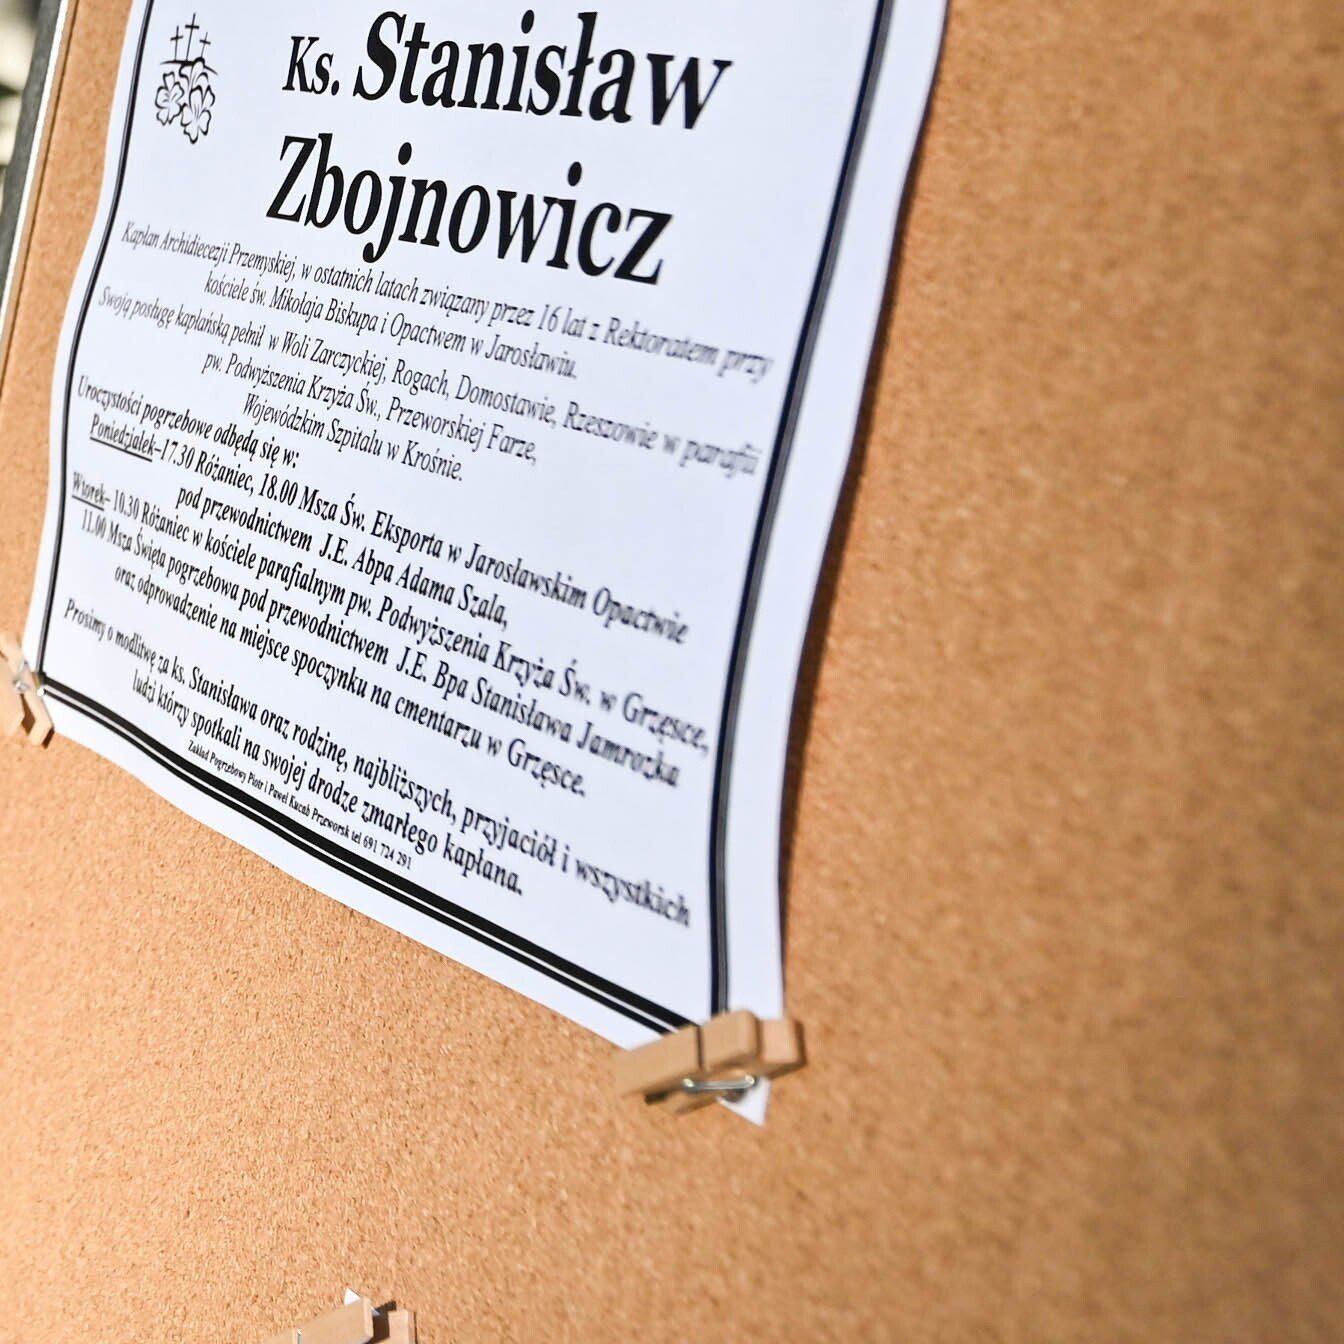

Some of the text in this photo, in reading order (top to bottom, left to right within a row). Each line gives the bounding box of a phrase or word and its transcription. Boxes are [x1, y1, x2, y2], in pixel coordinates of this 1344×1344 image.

[282, 9, 732, 130] Ks. Stanisław
[265, 132, 674, 286] Zbojnowicz
[159, 230, 231, 268] Archidiecezji
[228, 242, 298, 284] Przemyskiej,
[301, 263, 313, 281] w
[313, 265, 374, 294] ostatnich
[374, 270, 420, 304] latach
[419, 285, 490, 324] związany
[487, 302, 536, 328] przez
[537, 304, 563, 333] 16
[561, 307, 588, 339] lat
[587, 322, 601, 342] z
[204, 270, 577, 380] kościele św. Mikołaja Biskupa i Opactwem w Jarosławiu.
[77, 375, 300, 470] Uroczystości pogrzebowe odbędą się w:
[98, 286, 133, 318] Swoją
[268, 334, 280, 351] w
[281, 330, 312, 360] Woli
[309, 338, 389, 386] Zarczyckiej,
[391, 358, 450, 401] Rogach,
[454, 374, 557, 430] Domostawie,
[663, 434, 681, 454] w
[201, 352, 537, 466] pw. Podwyższenia Krzyża Św., Przeworskiej Farze,
[242, 392, 463, 482] Wojewódzkim Szpitalu w Krośnie.
[113, 489, 140, 521] 10.30
[140, 501, 190, 543] Różaniec
[192, 529, 204, 548] w
[204, 527, 257, 570] kościele
[255, 556, 346, 606] parafialnym
[343, 591, 372, 618] pw.
[375, 595, 491, 664] Podwyższenia
[491, 640, 556, 691] Krzyża
[557, 658, 591, 706] Św.
[600, 690, 618, 713] w
[174, 486, 204, 510] pod
[199, 496, 313, 553] przewodnictwem
[350, 546, 396, 586] Abpa
[394, 562, 456, 606] Adama
[457, 583, 508, 633] Szala,
[194, 450, 254, 498] Różaniec,
[257, 473, 299, 507] 18.00
[297, 485, 339, 522] Msza
[339, 492, 366, 533] Św.
[369, 509, 445, 560] Eksporta
[447, 544, 463, 564] w
[464, 542, 588, 610] Jarosławskim
[81, 508, 108, 540] 11.00
[107, 520, 133, 552] Msza
[133, 526, 167, 571] Święta
[165, 556, 240, 602] pogrzebowa
[238, 587, 270, 614] pod
[265, 599, 390, 666] przewodnictwem
[431, 660, 470, 702] Bpa
[470, 676, 574, 744] Stanisława
[114, 566, 137, 592] oraz
[137, 573, 219, 630] odprowadzenie
[219, 617, 238, 640] na
[239, 623, 290, 663] miejsce
[291, 649, 369, 699] spoczynku
[370, 684, 393, 710] na
[394, 696, 483, 750] cmentarzu
[487, 735, 503, 758] w
[63, 598, 691, 928] Prosimy o modlitwę za ks. Stanisława oraz rodzinę, najbliższych, przyjaciół i wszystkich
[132, 668, 523, 897] ludzi którzy spotkali na swojej drodze zmarłego kapłana.
[310, 807, 350, 840] Przeworsk
